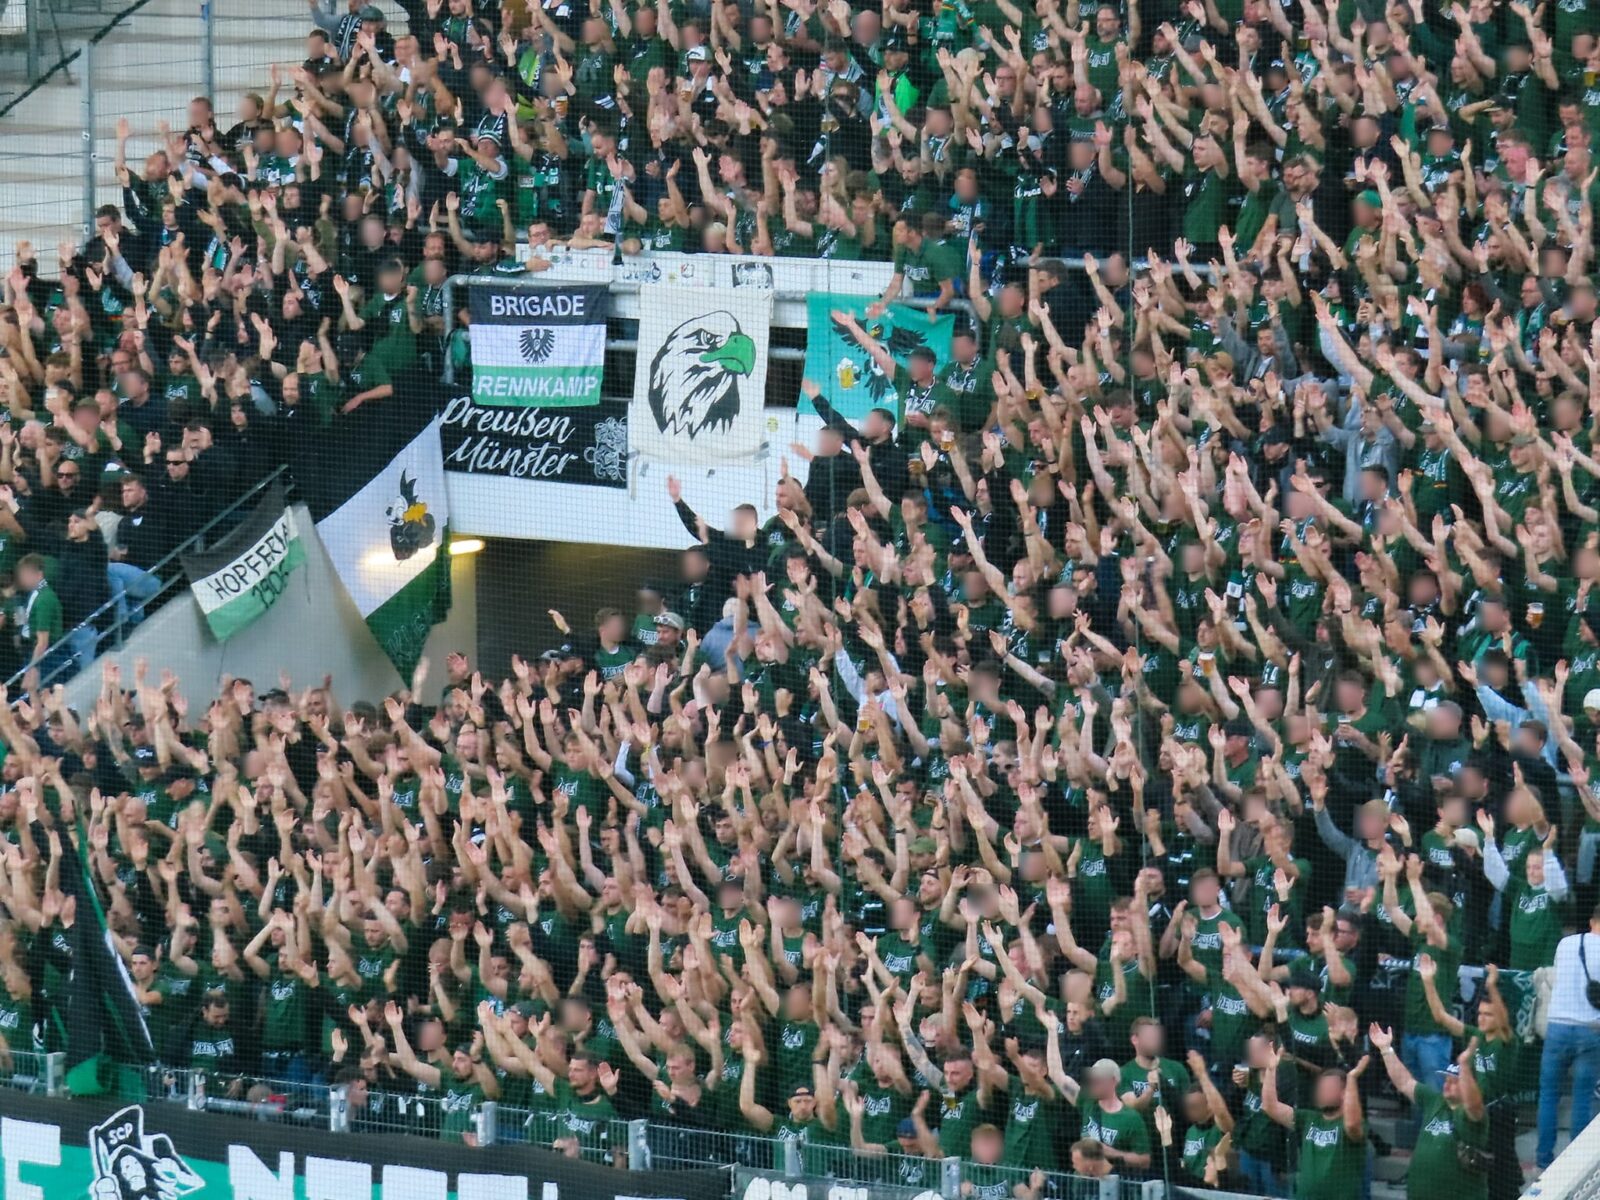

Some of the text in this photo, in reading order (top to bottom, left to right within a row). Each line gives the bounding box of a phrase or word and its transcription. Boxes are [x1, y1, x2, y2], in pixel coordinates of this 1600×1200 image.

[491, 295, 585, 316] BRIGADE
[477, 375, 599, 398] RENNKAMP
[438, 396, 576, 444] Preußen
[443, 436, 579, 477] Münster
[109, 1122, 134, 1145] SCP
